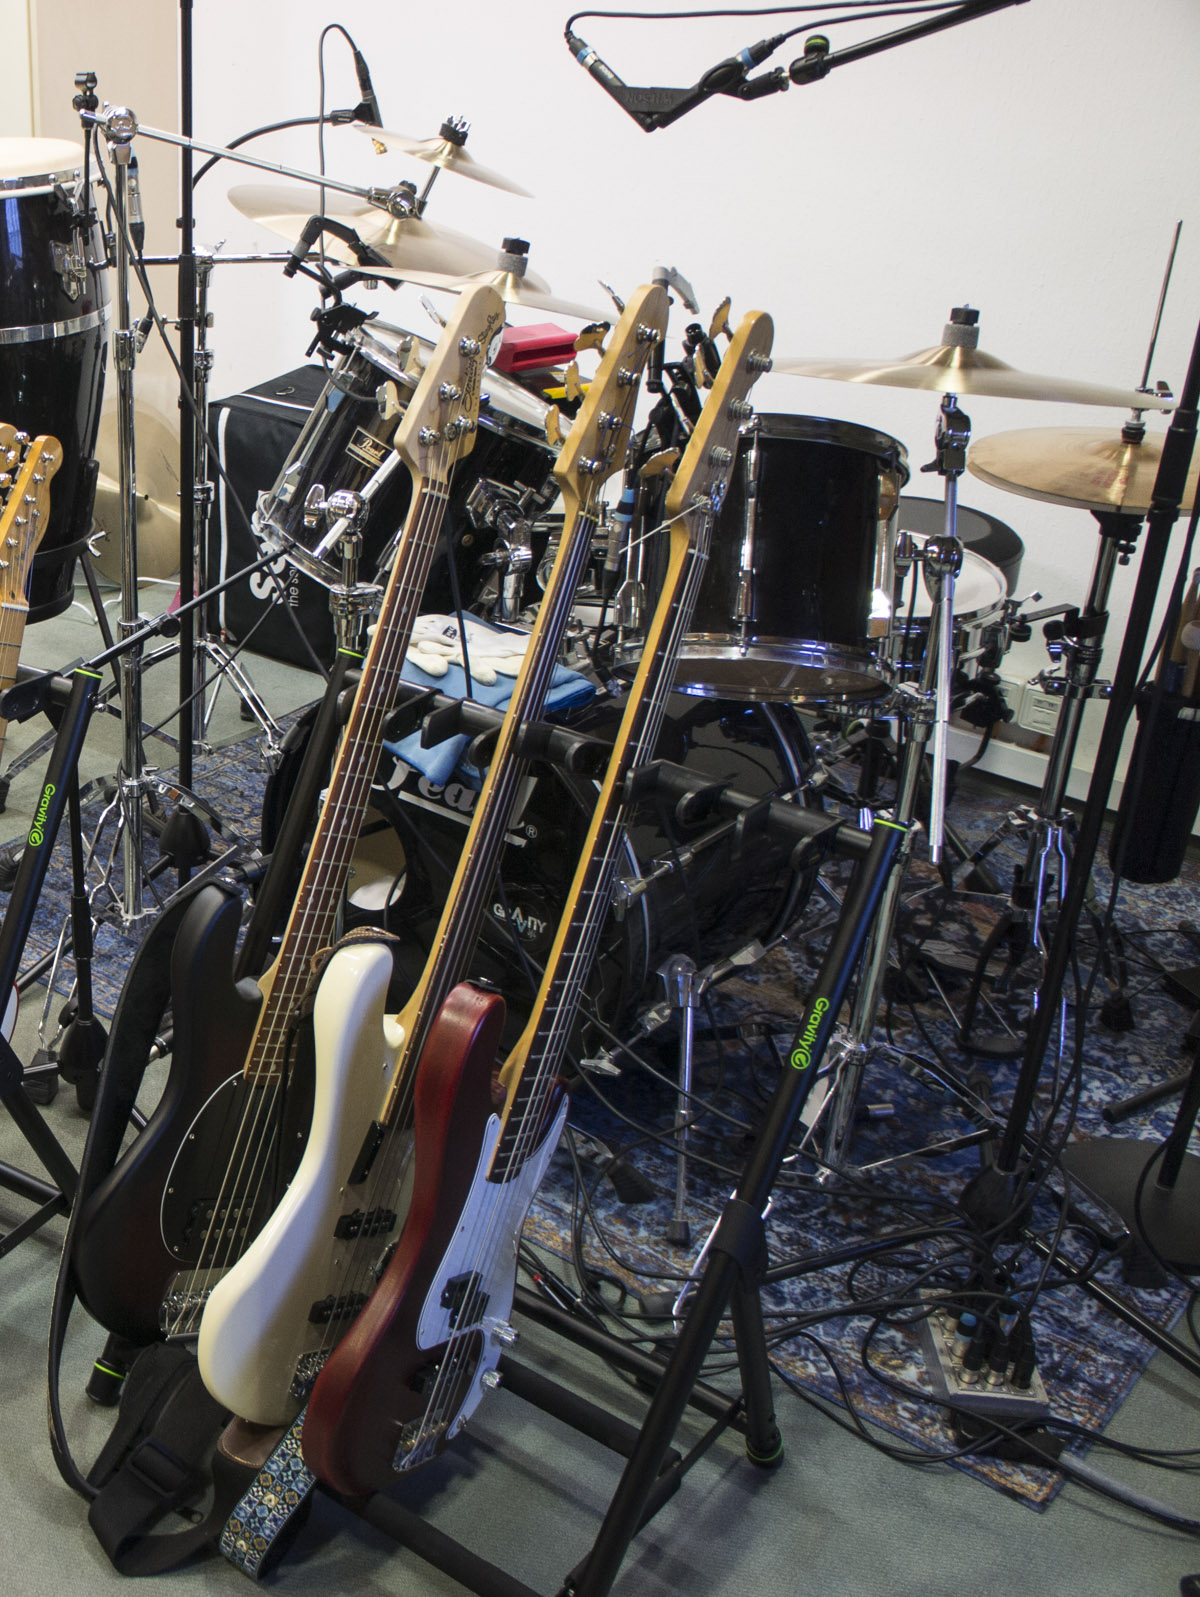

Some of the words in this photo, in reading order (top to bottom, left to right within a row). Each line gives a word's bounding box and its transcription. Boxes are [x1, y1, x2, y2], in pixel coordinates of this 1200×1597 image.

[357, 437, 386, 460] Pearl
[34, 783, 56, 830] Gravity
[799, 997, 830, 1051] Gravity
